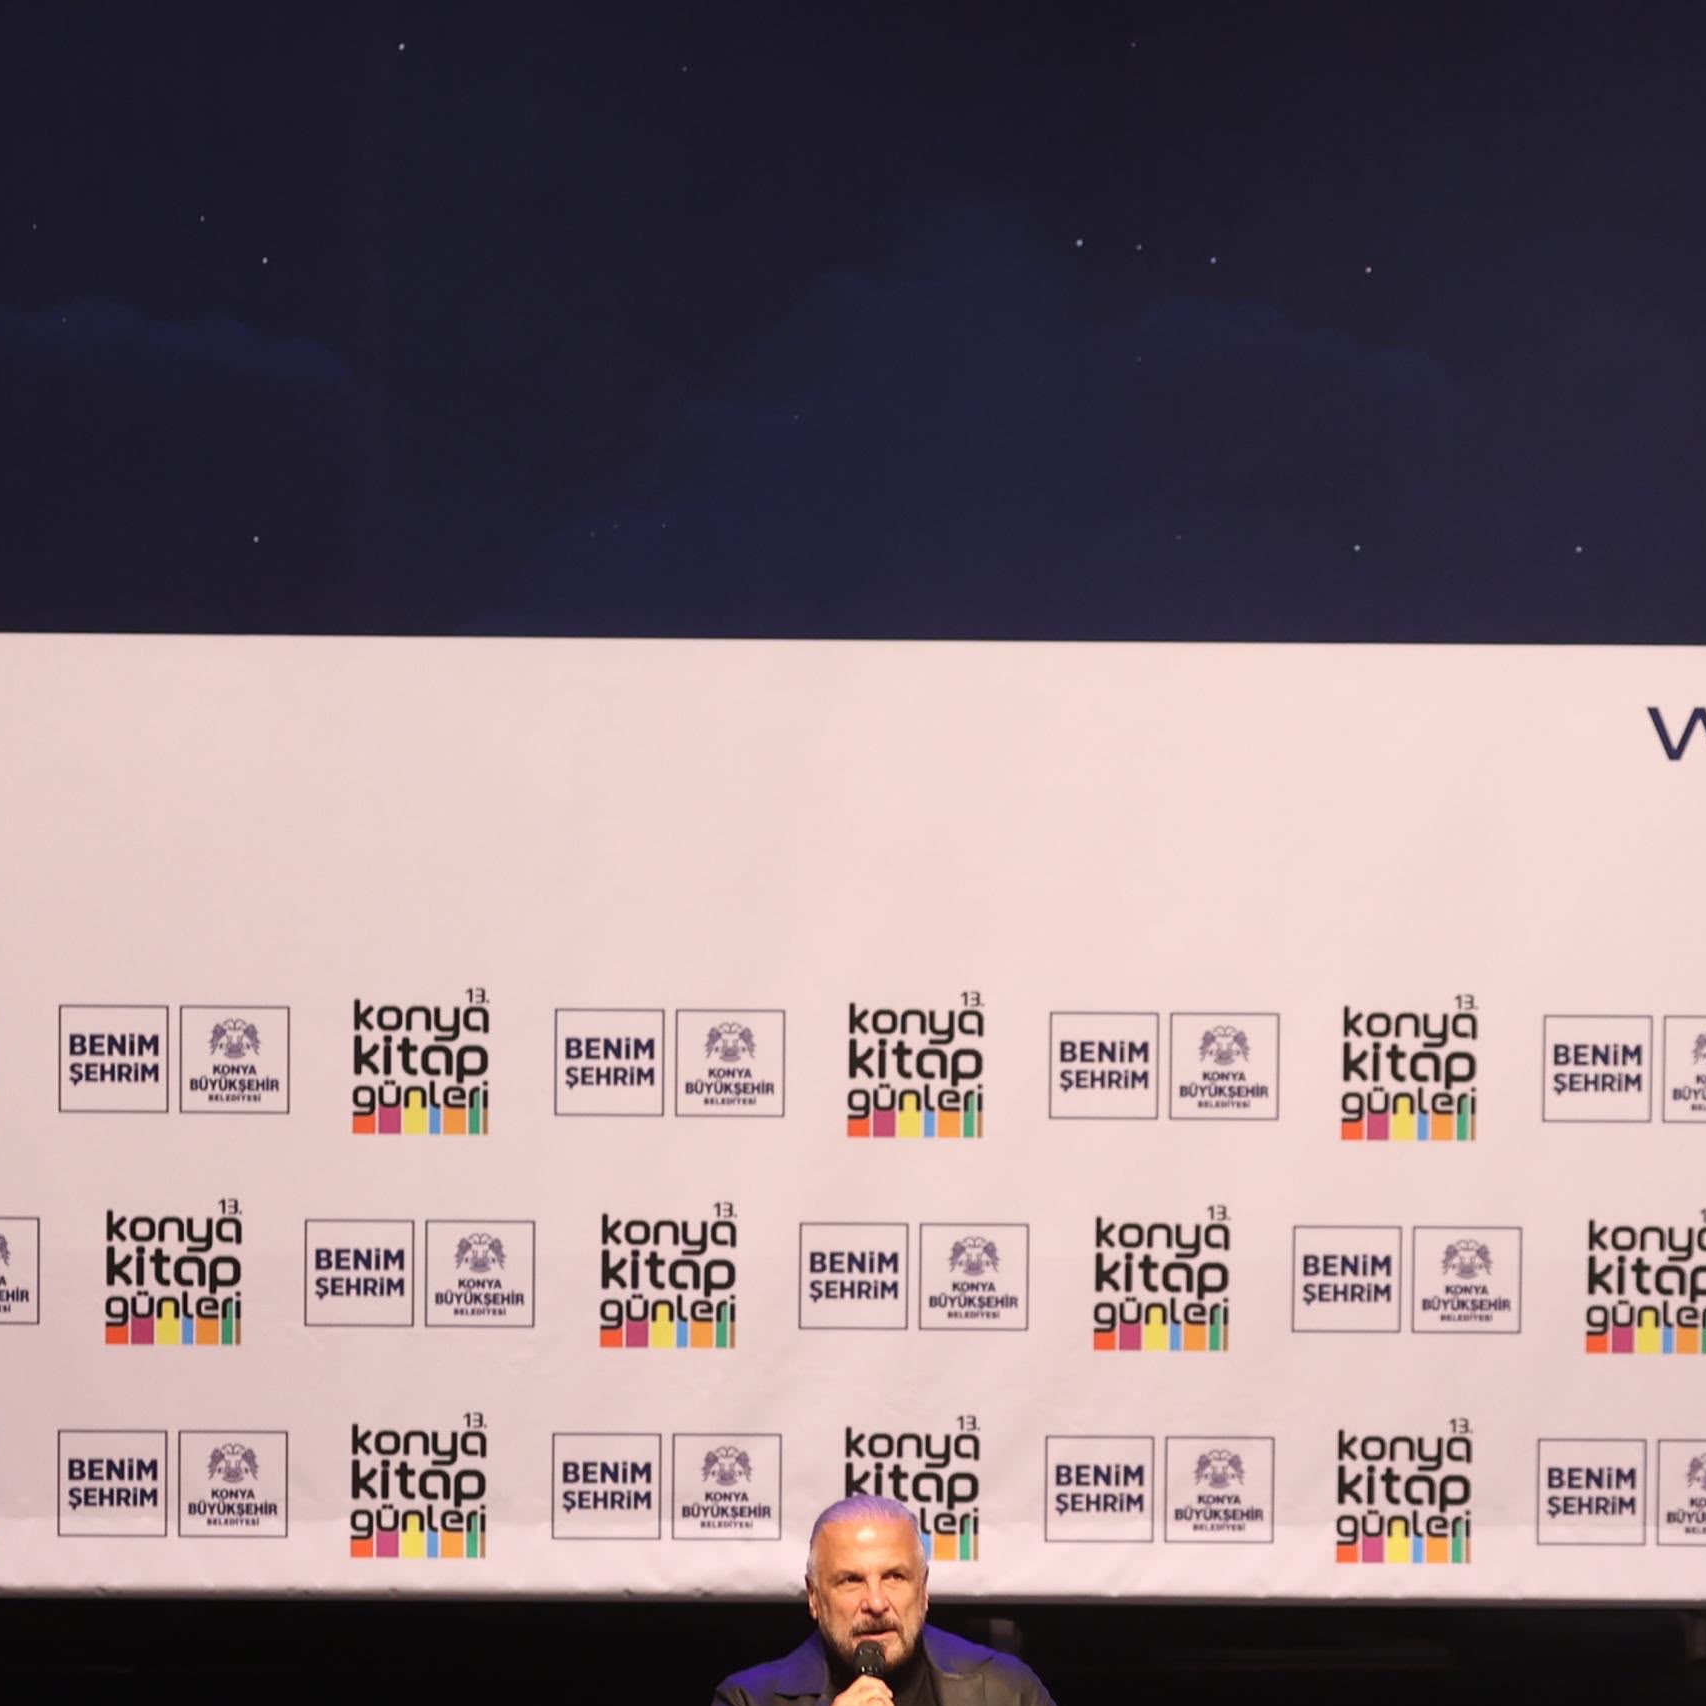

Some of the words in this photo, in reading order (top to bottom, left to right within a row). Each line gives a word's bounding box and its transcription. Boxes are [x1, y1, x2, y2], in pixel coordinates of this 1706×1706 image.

[352, 1000, 489, 1042] konya
[1341, 1006, 1478, 1048] konya
[213, 1064, 257, 1074] KONYA
[352, 1036, 489, 1083] kitap
[1203, 1071, 1247, 1082] KONYA
[1341, 1042, 1478, 1089] kitap
[190, 1075, 280, 1091] BÜYÜKŞEHİR
[352, 1080, 489, 1116] günleri
[1180, 1082, 1270, 1098] BÜYÜKŞEHİR
[1340, 1086, 1476, 1122] günleri
[600, 1214, 737, 1256] konya
[458, 1278, 502, 1288] KONYA
[600, 1250, 737, 1297] kitap
[1445, 1284, 1489, 1294] KONYA
[435, 1289, 525, 1305] BÜYÜKŞEHİR
[600, 1294, 737, 1330] günleri
[1422, 1295, 1512, 1311] BÜYÜKŞEHİR
[844, 1426, 979, 1468] konya
[705, 1491, 749, 1502] KONYA
[844, 1462, 979, 1509] kitap
[682, 1502, 772, 1518] BÜYÜKŞEHİR
